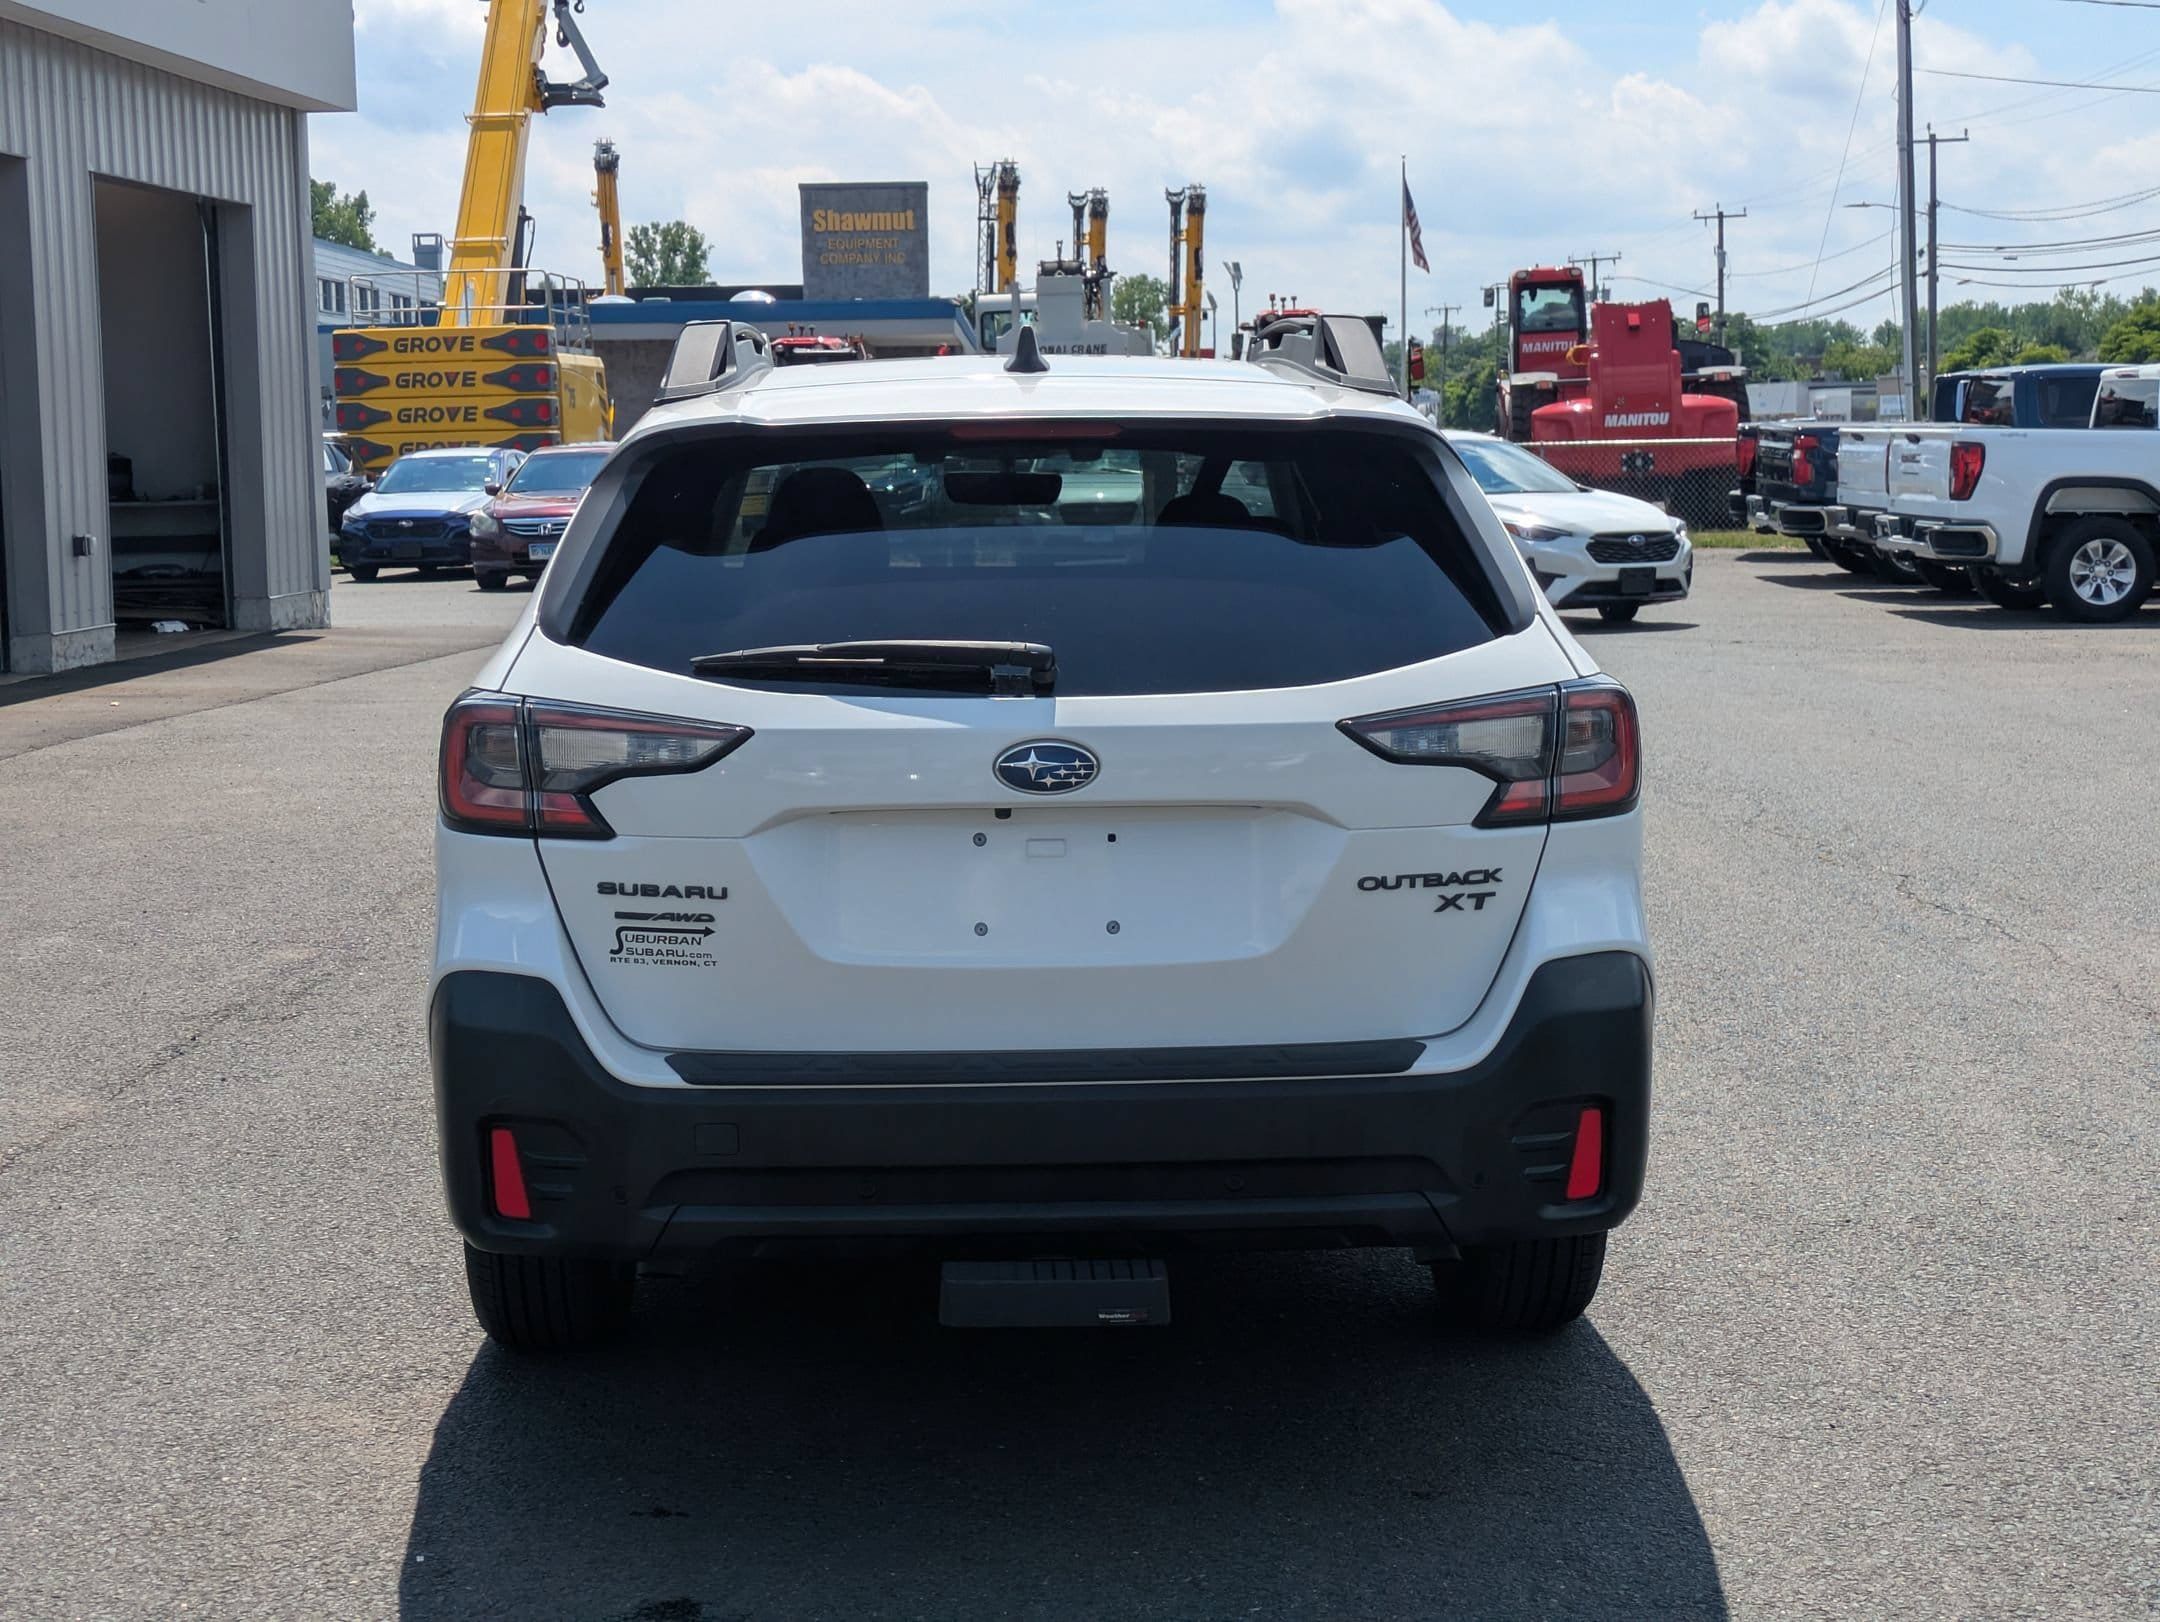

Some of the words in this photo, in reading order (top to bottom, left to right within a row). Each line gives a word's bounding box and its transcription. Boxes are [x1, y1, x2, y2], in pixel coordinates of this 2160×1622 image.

[813, 208, 915, 232] Shawmut
[827, 238, 899, 249] EQUIPMENT
[820, 253, 881, 265] COMPANY
[393, 335, 475, 353] GROVE
[1522, 340, 1577, 353] MANITOU
[395, 371, 477, 389] GROVE
[396, 406, 478, 423] GROVE
[1604, 412, 1670, 428] MANITOU
[1357, 867, 1503, 891] OUTBACK
[596, 881, 728, 900] SUBARU
[1433, 891, 1496, 912] XT
[651, 912, 716, 923] AWD
[625, 947, 713, 959] SUBARU.com
[652, 958, 700, 967] VERNON,
